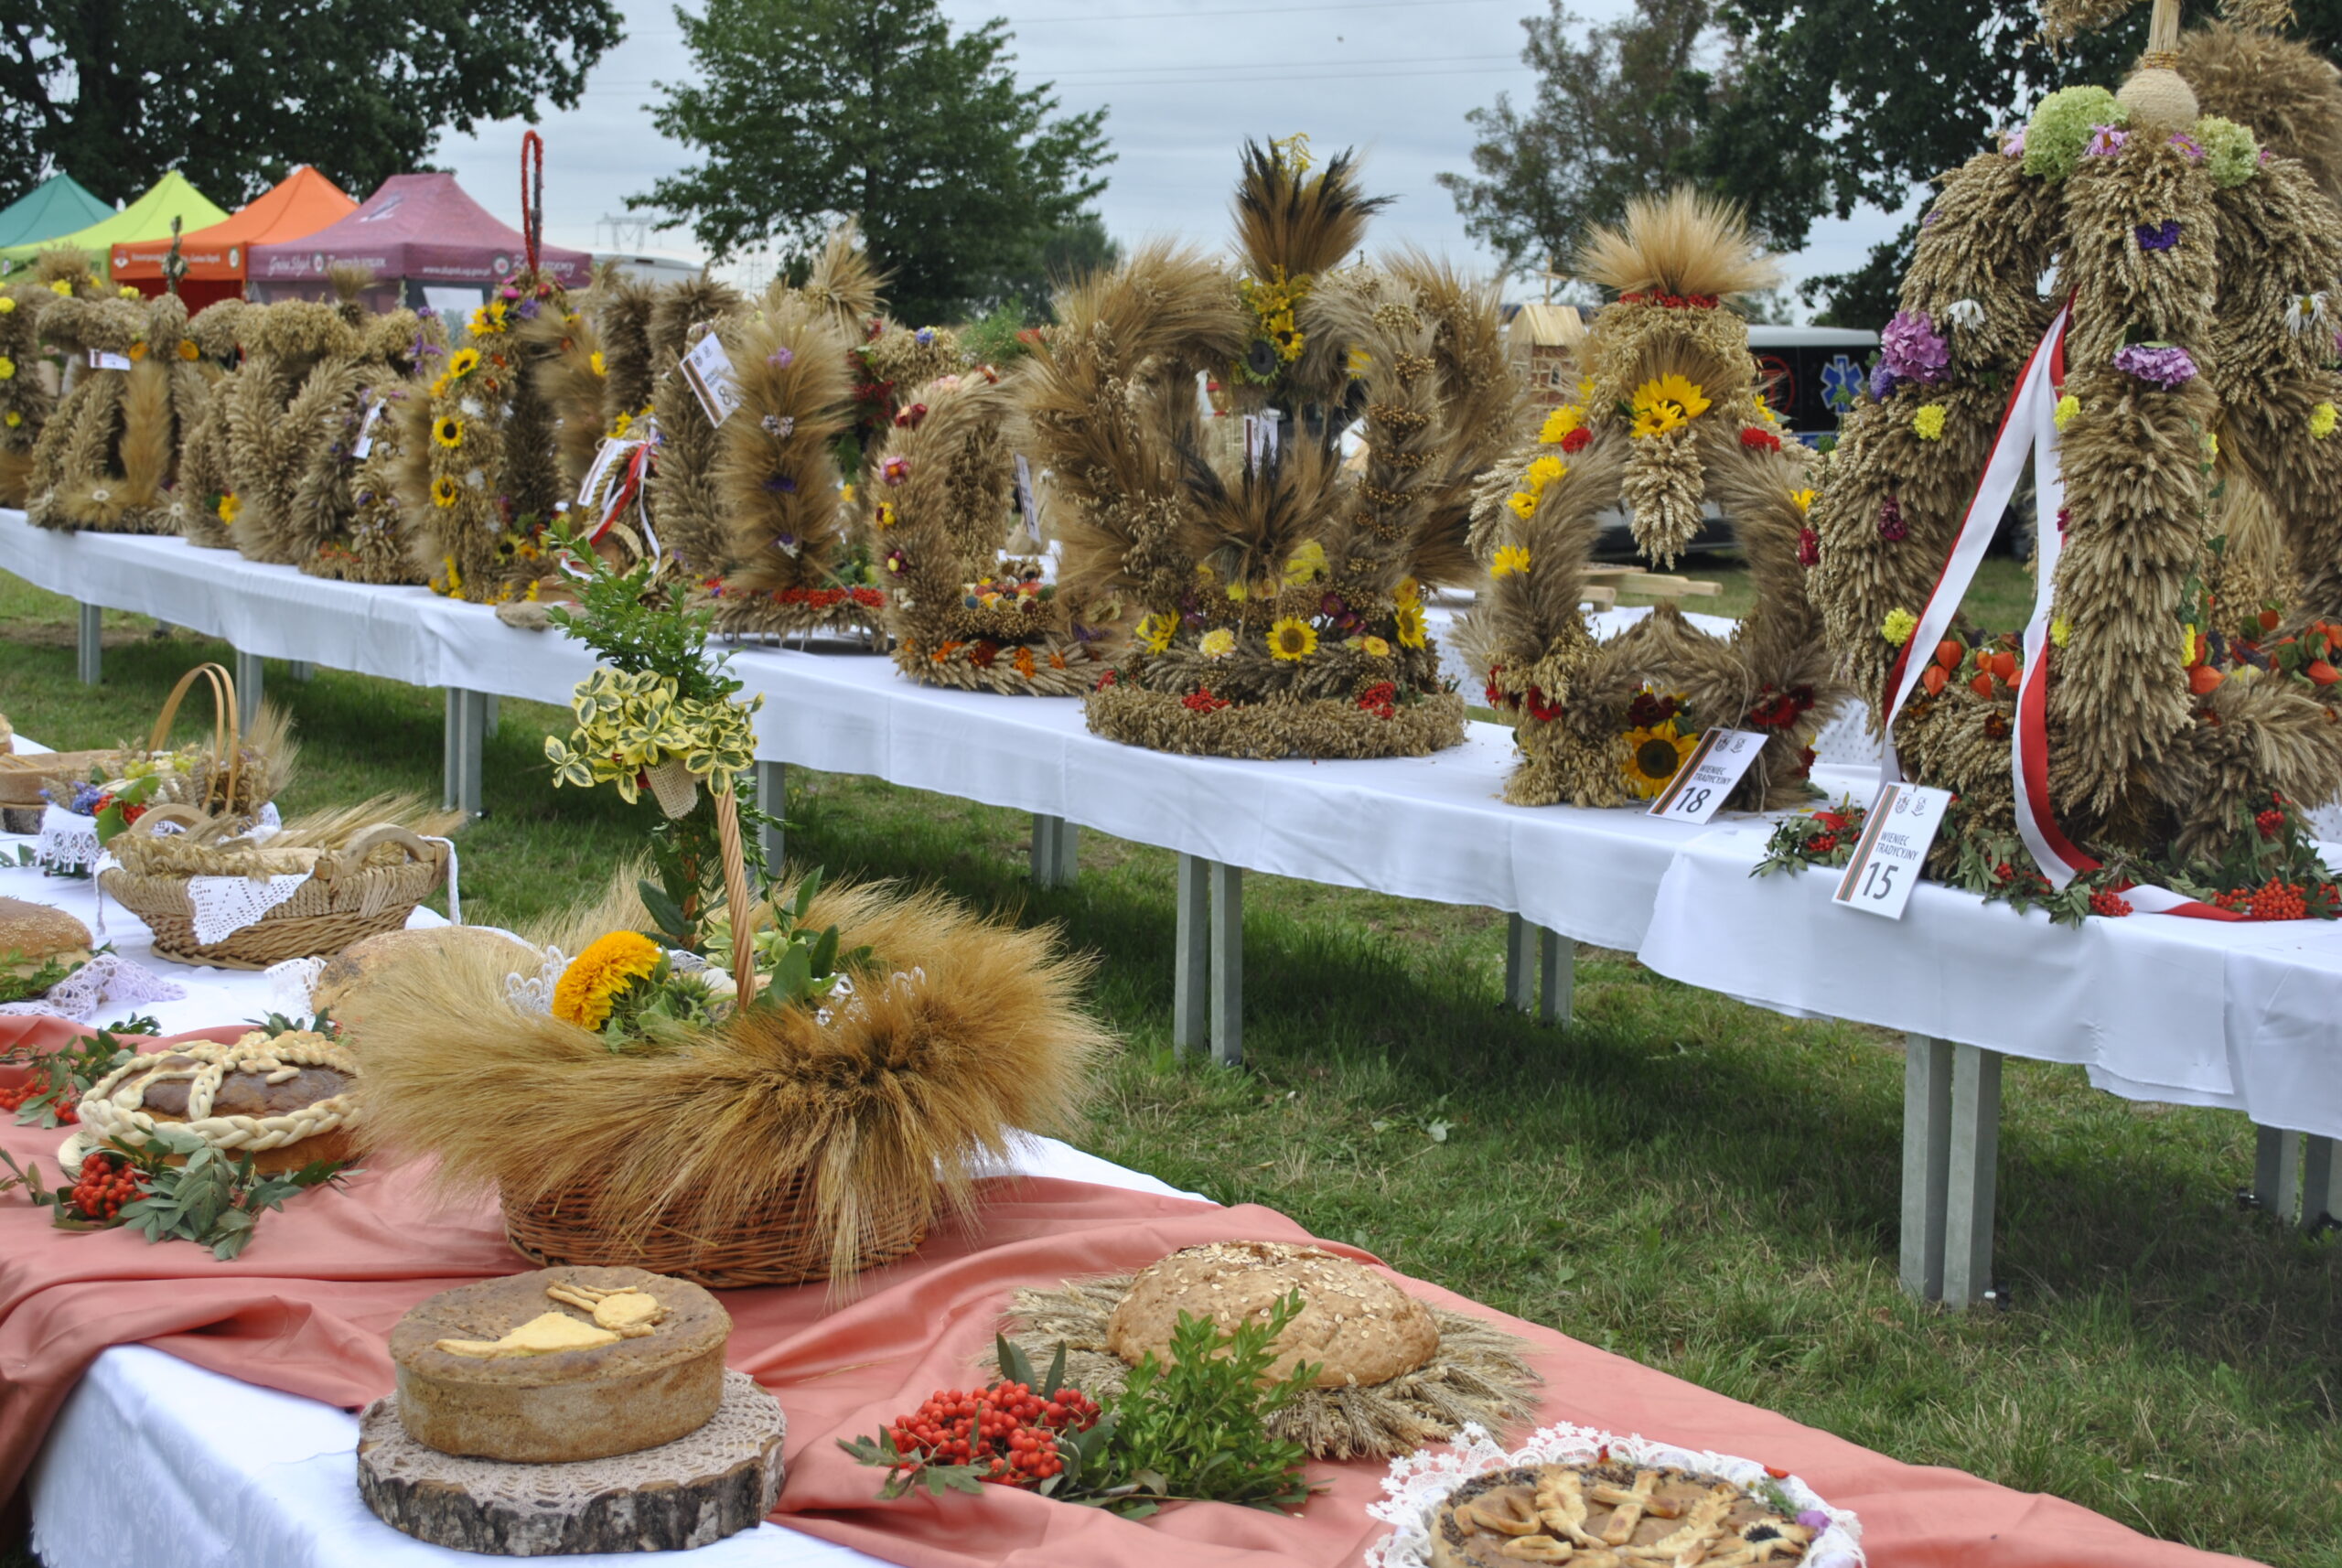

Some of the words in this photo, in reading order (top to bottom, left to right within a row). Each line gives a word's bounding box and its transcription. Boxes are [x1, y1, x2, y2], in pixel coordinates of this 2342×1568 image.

[718, 386, 732, 405] 8
[1693, 772, 1733, 786] TRADYCYJNY
[1699, 765, 1727, 776] WIENIEC
[1675, 787, 1712, 813] 18
[1880, 832, 1910, 845] WIENIEC
[1875, 843, 1919, 861] TRADYCYJNY
[1863, 862, 1899, 900] 15
